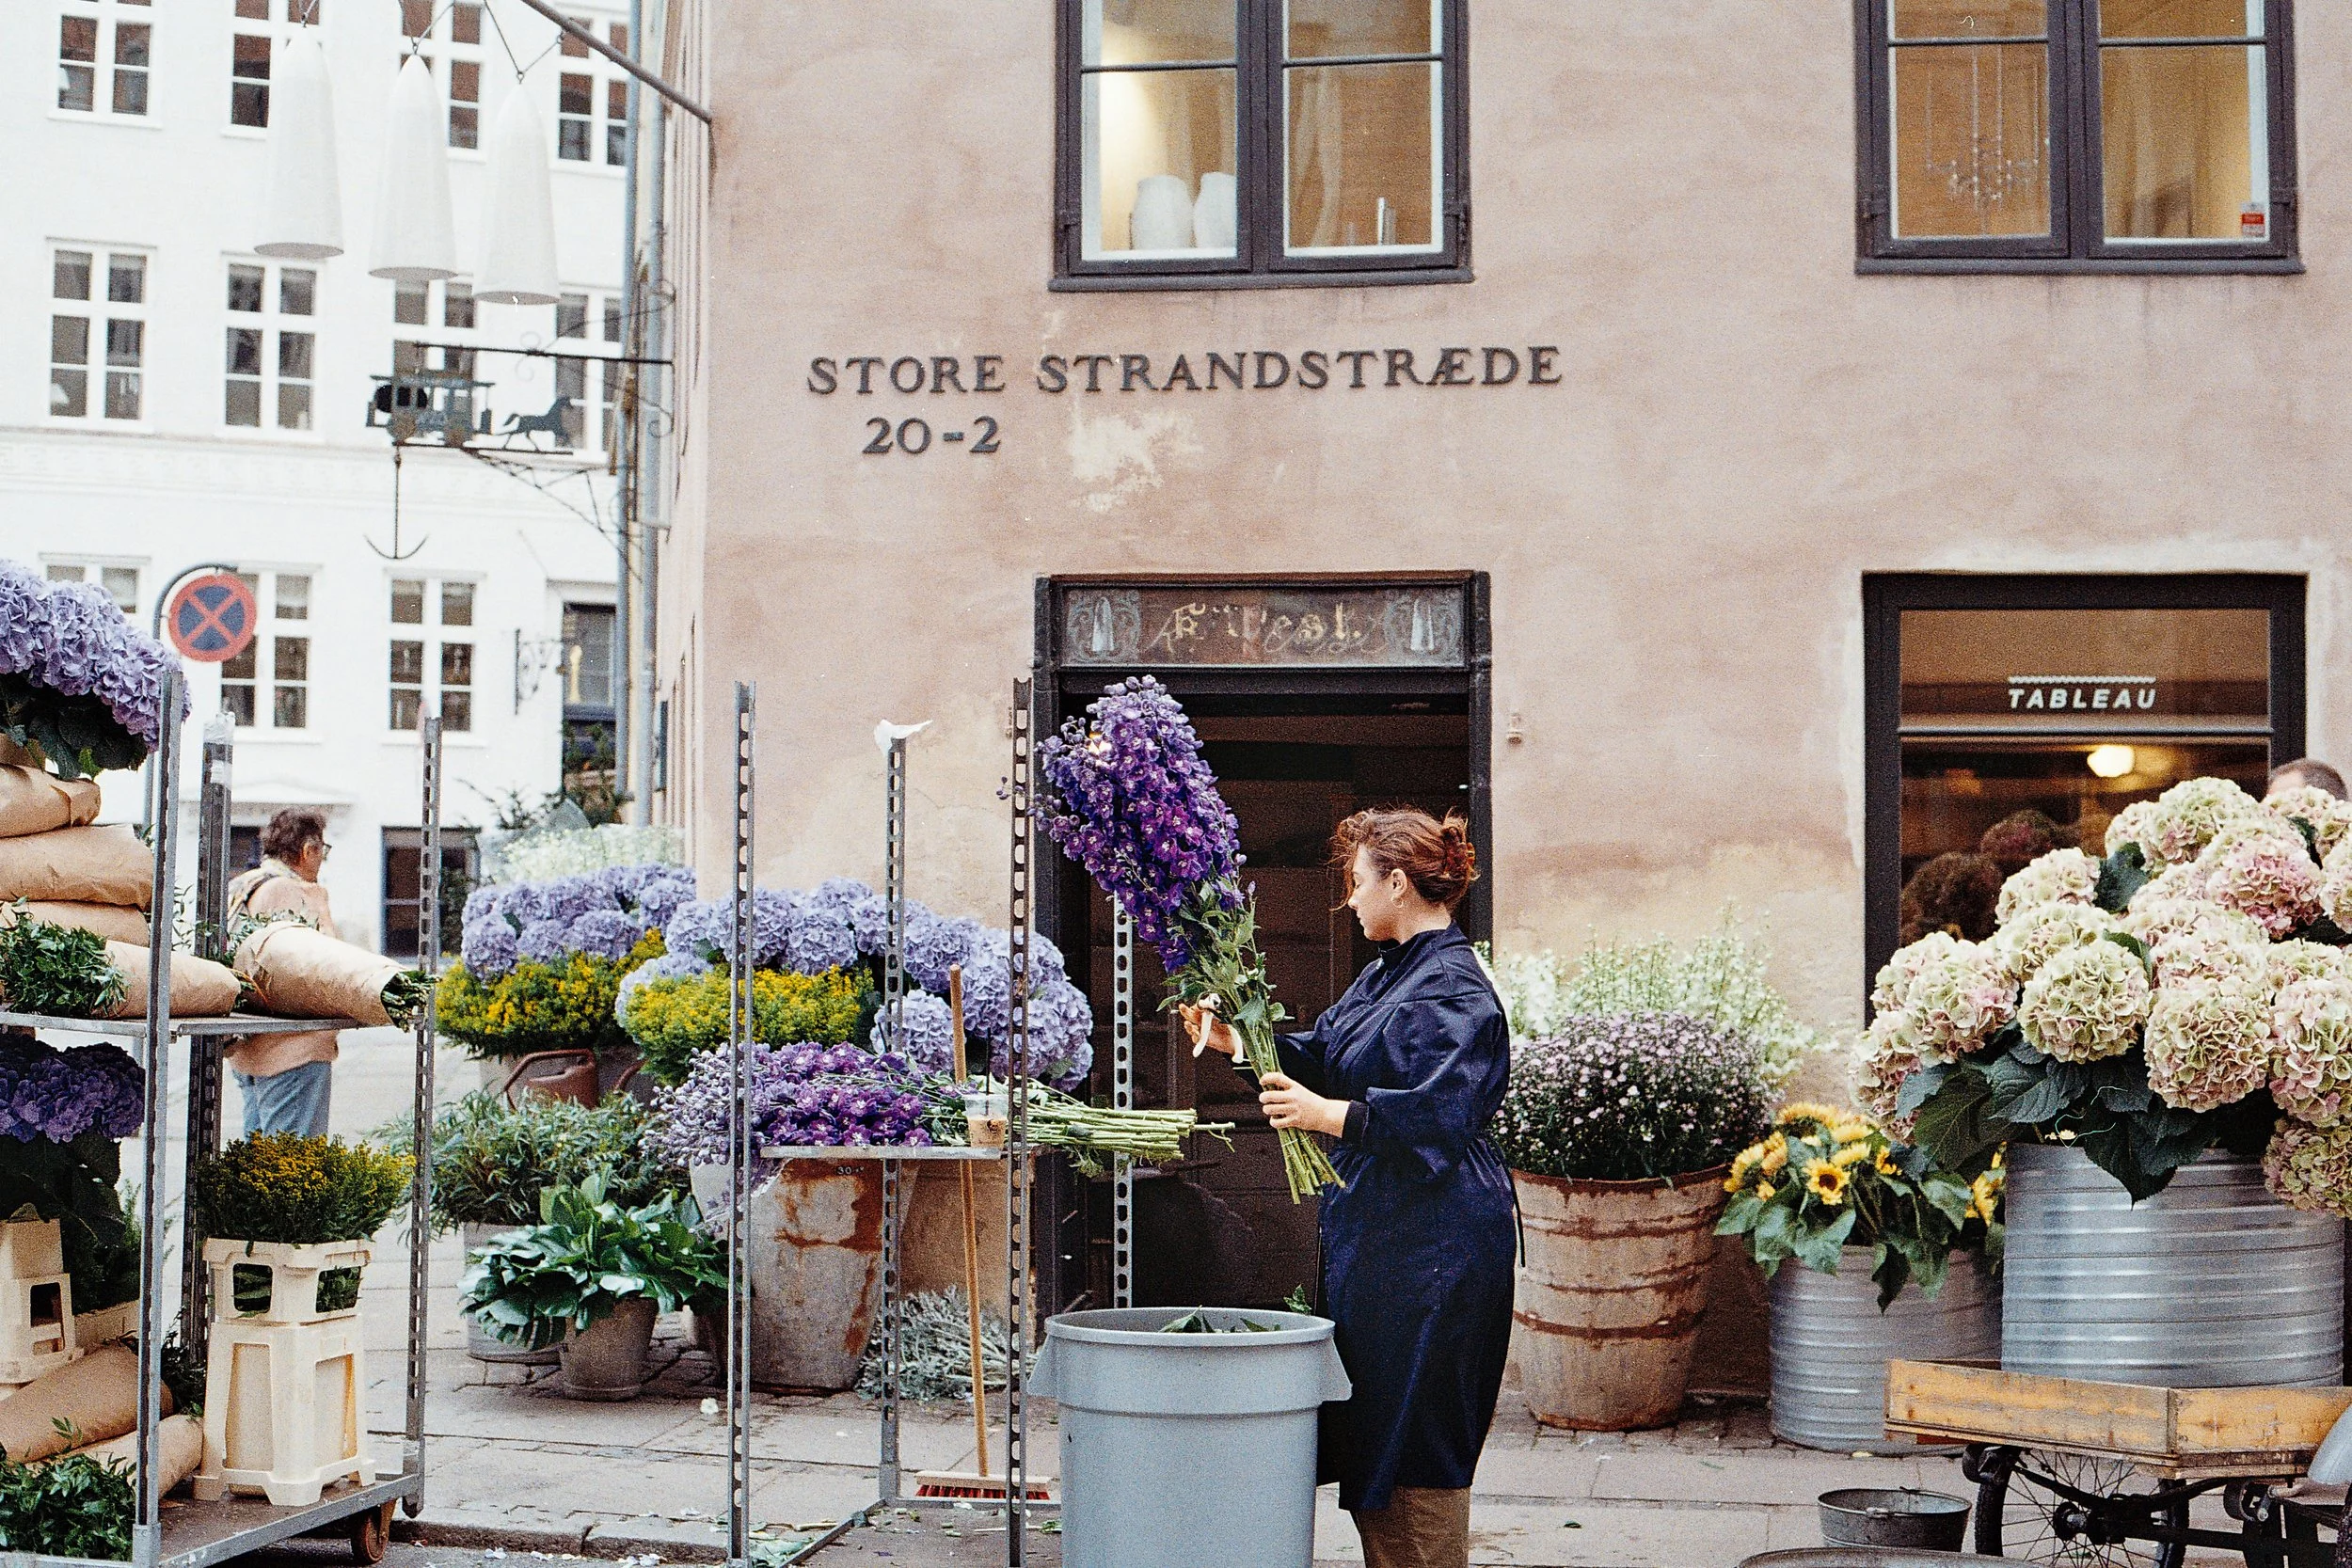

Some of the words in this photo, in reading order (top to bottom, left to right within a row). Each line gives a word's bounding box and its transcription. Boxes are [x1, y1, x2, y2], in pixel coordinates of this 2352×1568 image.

[808, 355, 1007, 396] STORE
[1036, 345, 1563, 395] STRANDSTRÆDE
[862, 416, 1002, 456] 20-2
[2008, 688, 2156, 709] TABLEAU
